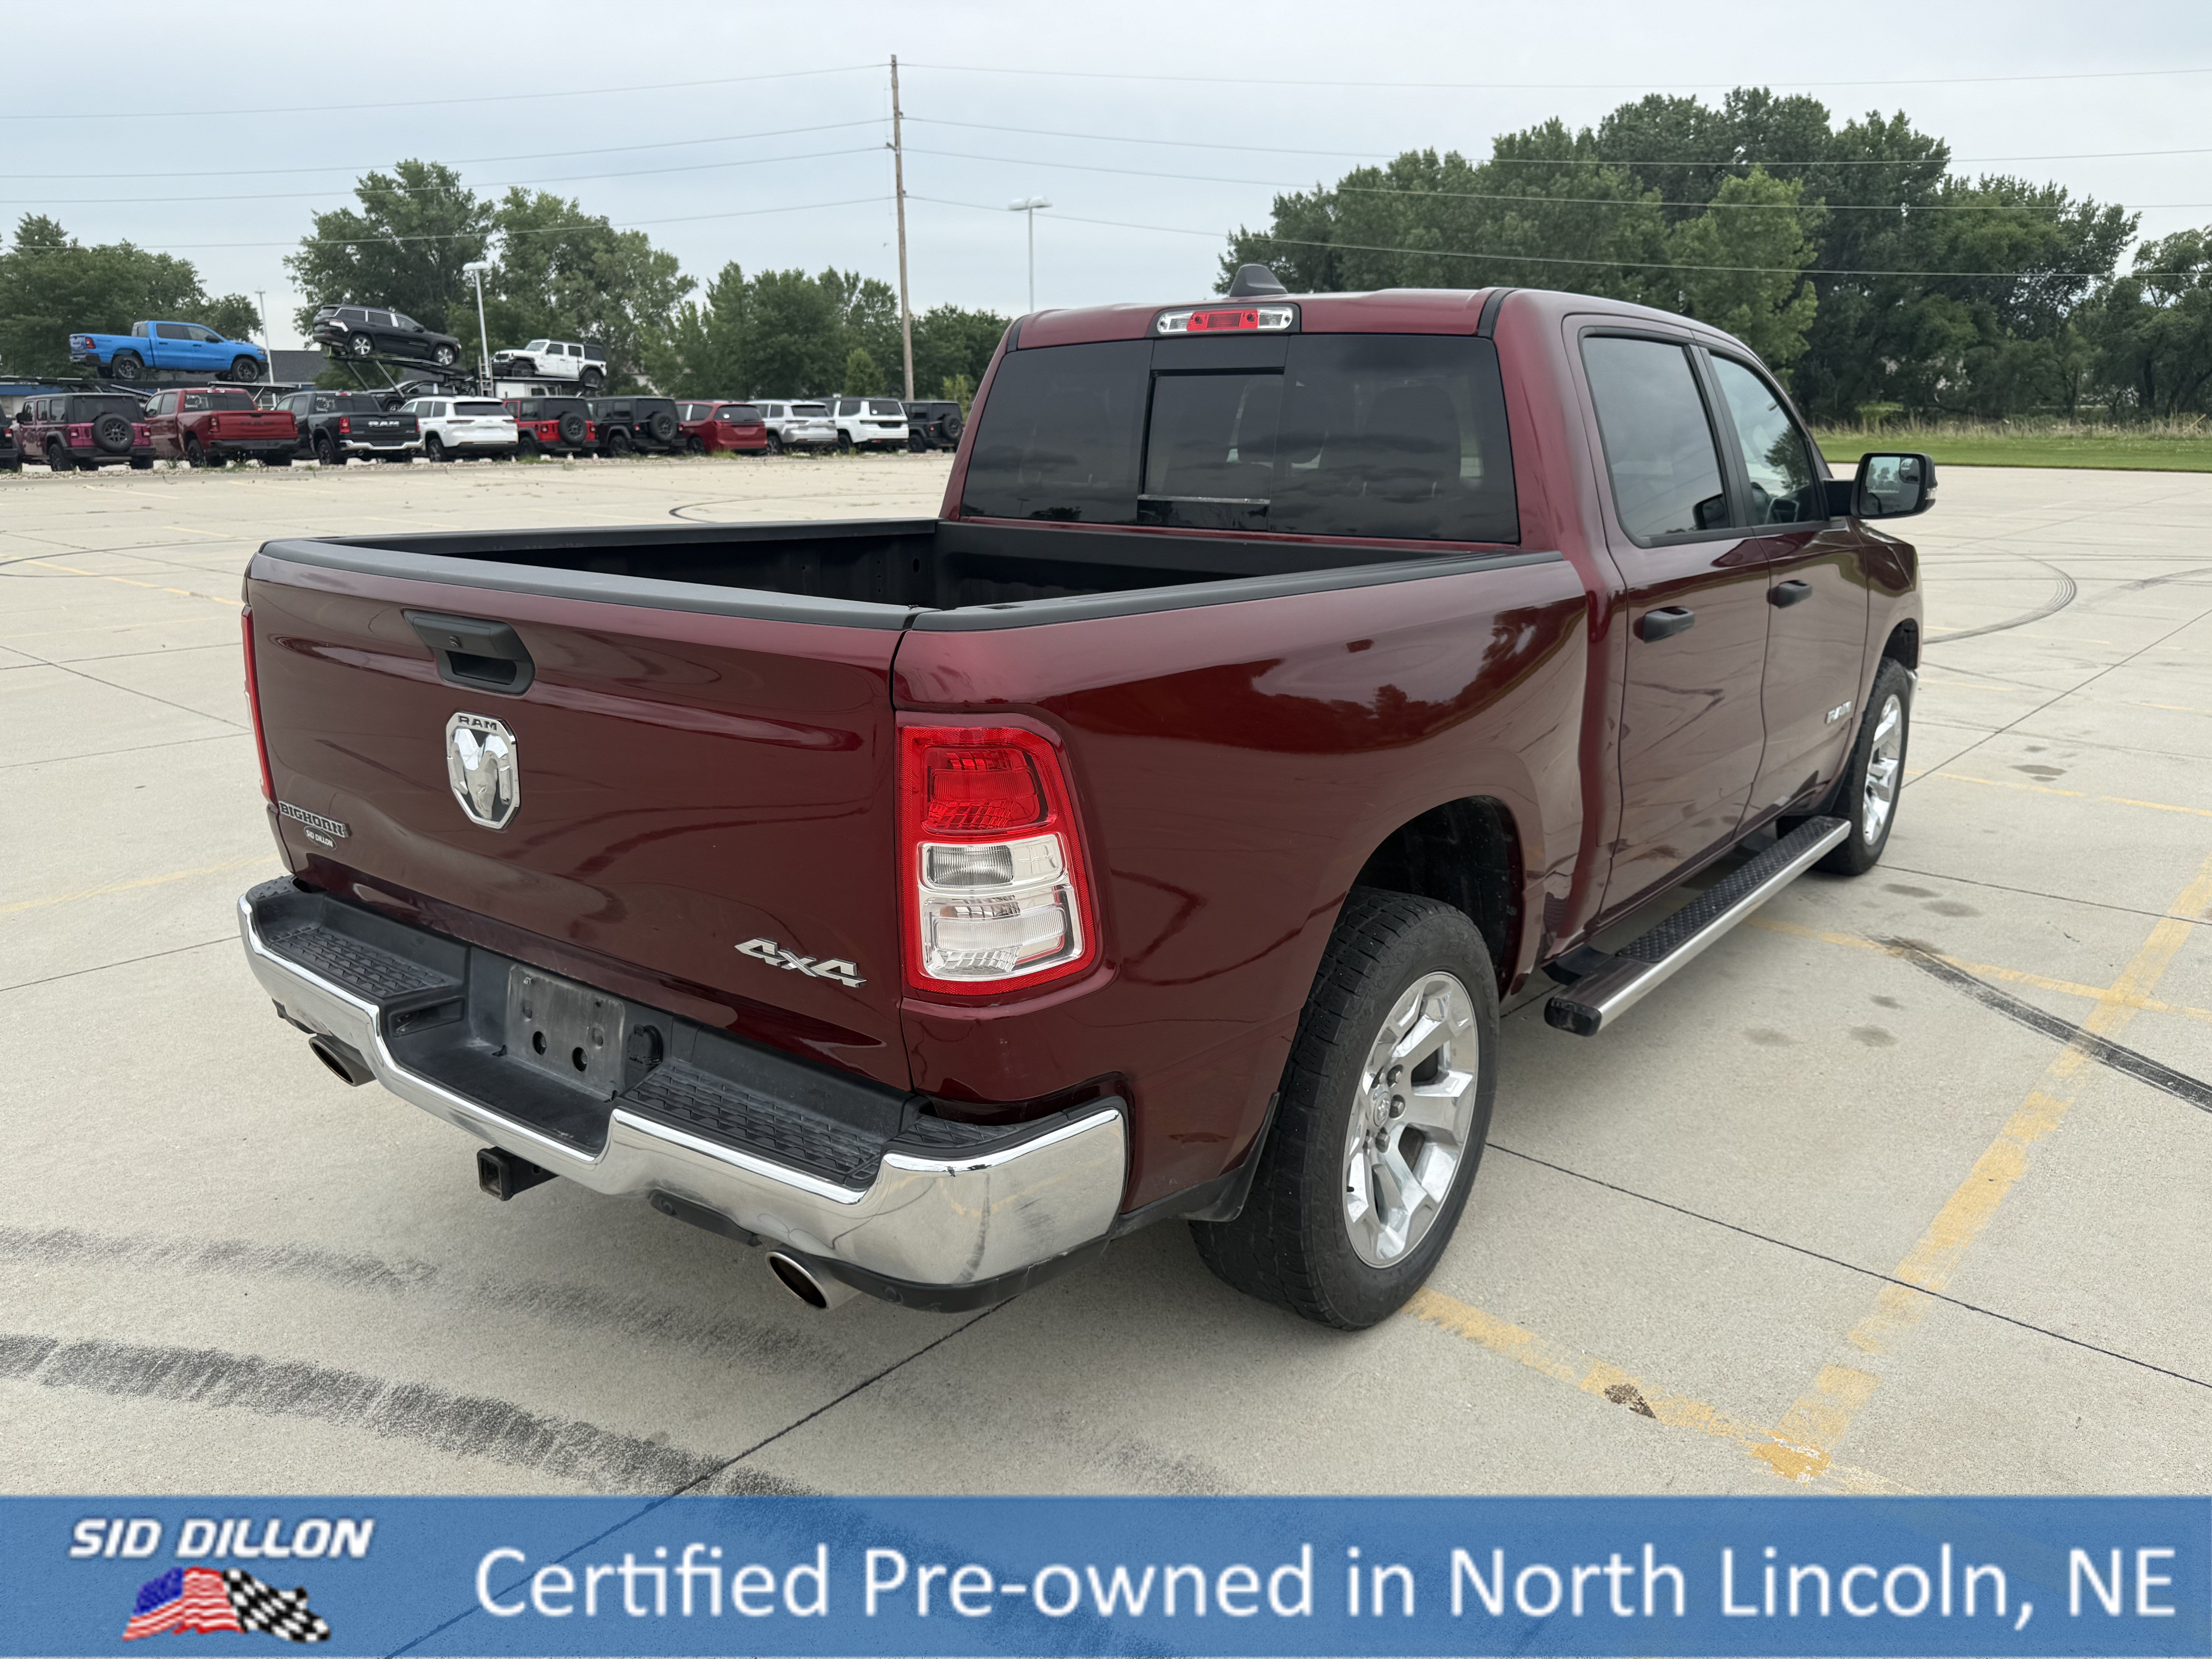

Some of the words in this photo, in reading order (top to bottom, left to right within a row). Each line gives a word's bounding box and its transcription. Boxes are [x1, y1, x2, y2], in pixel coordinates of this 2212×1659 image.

[459, 715, 497, 731] RAM
[279, 801, 345, 838] BIGHORN
[306, 830, 314, 839] SID
[315, 833, 333, 847] DILLON
